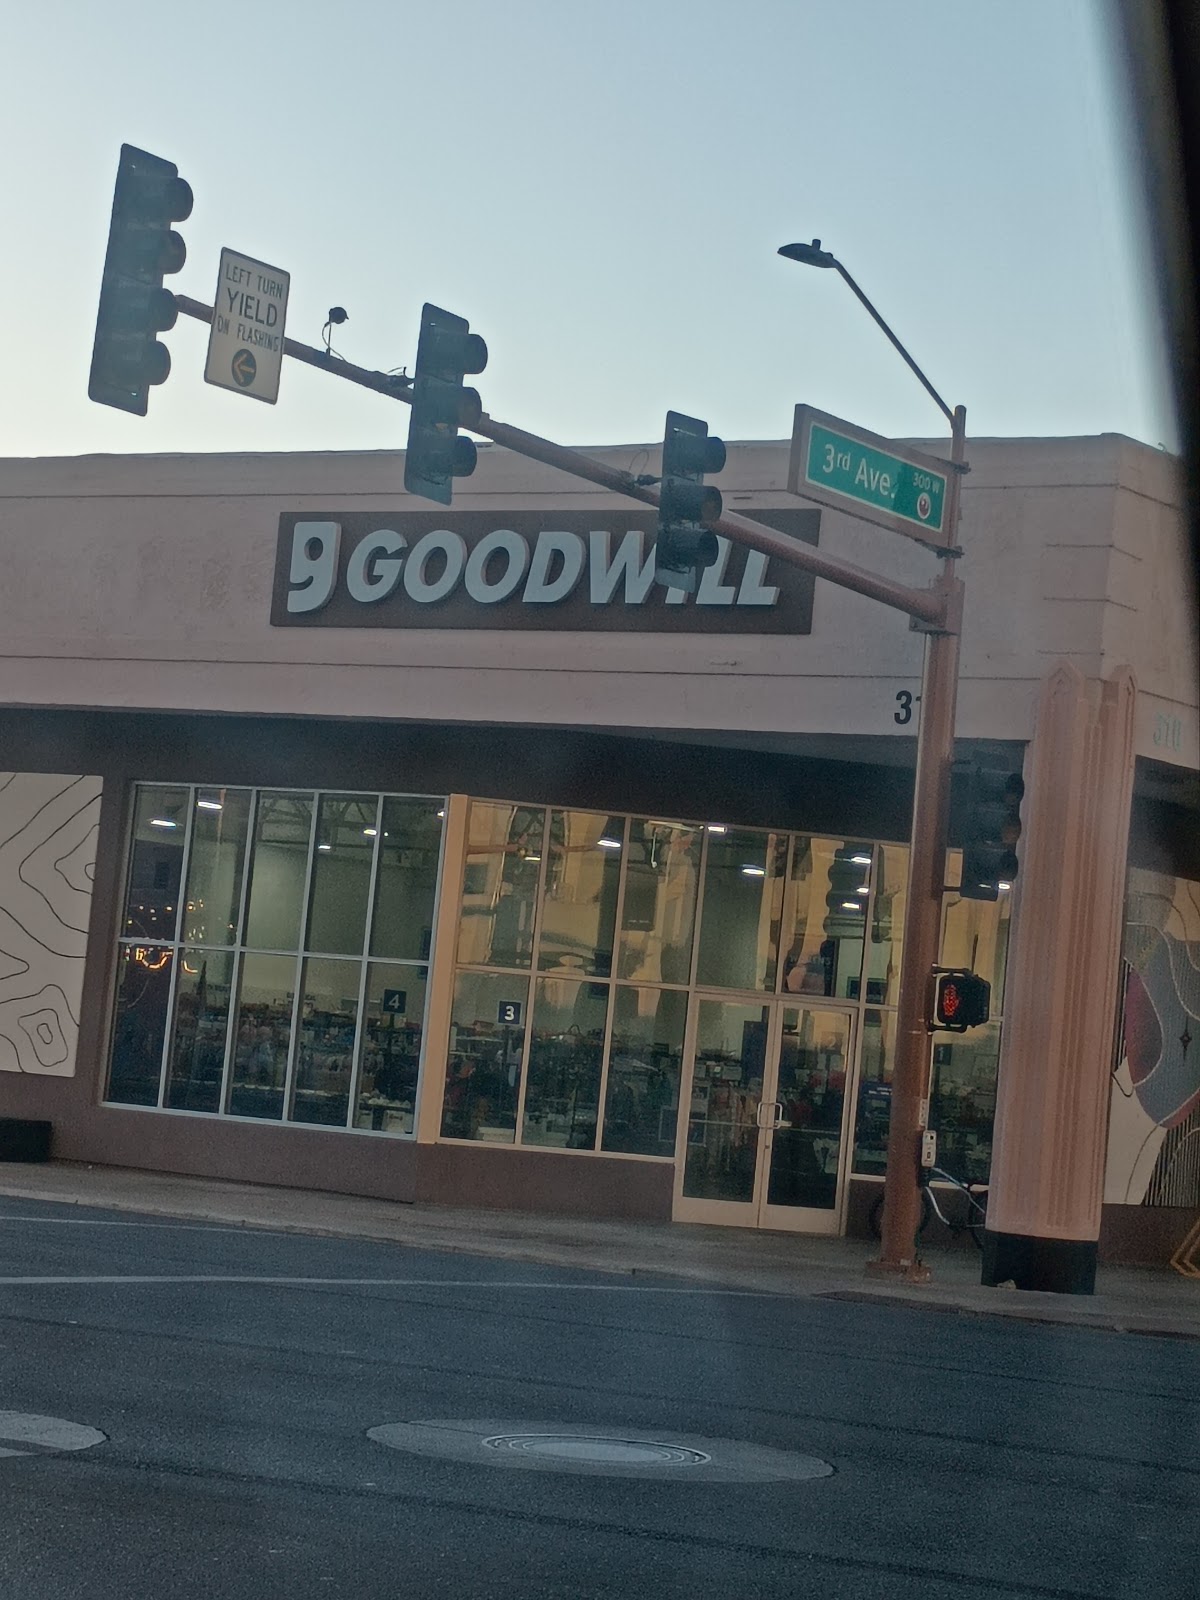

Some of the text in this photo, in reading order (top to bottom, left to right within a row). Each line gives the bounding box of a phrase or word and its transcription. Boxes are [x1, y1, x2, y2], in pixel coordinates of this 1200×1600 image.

[225, 263, 284, 300] LEFT TURN
[227, 287, 278, 328] YIELD
[217, 315, 280, 353] ON FLASHING
[822, 443, 896, 499] 3rd Ave.
[912, 472, 942, 494] 300 W
[345, 528, 780, 605] GOODWLL
[388, 993, 401, 1009] 4
[504, 1005, 515, 1021] 3
